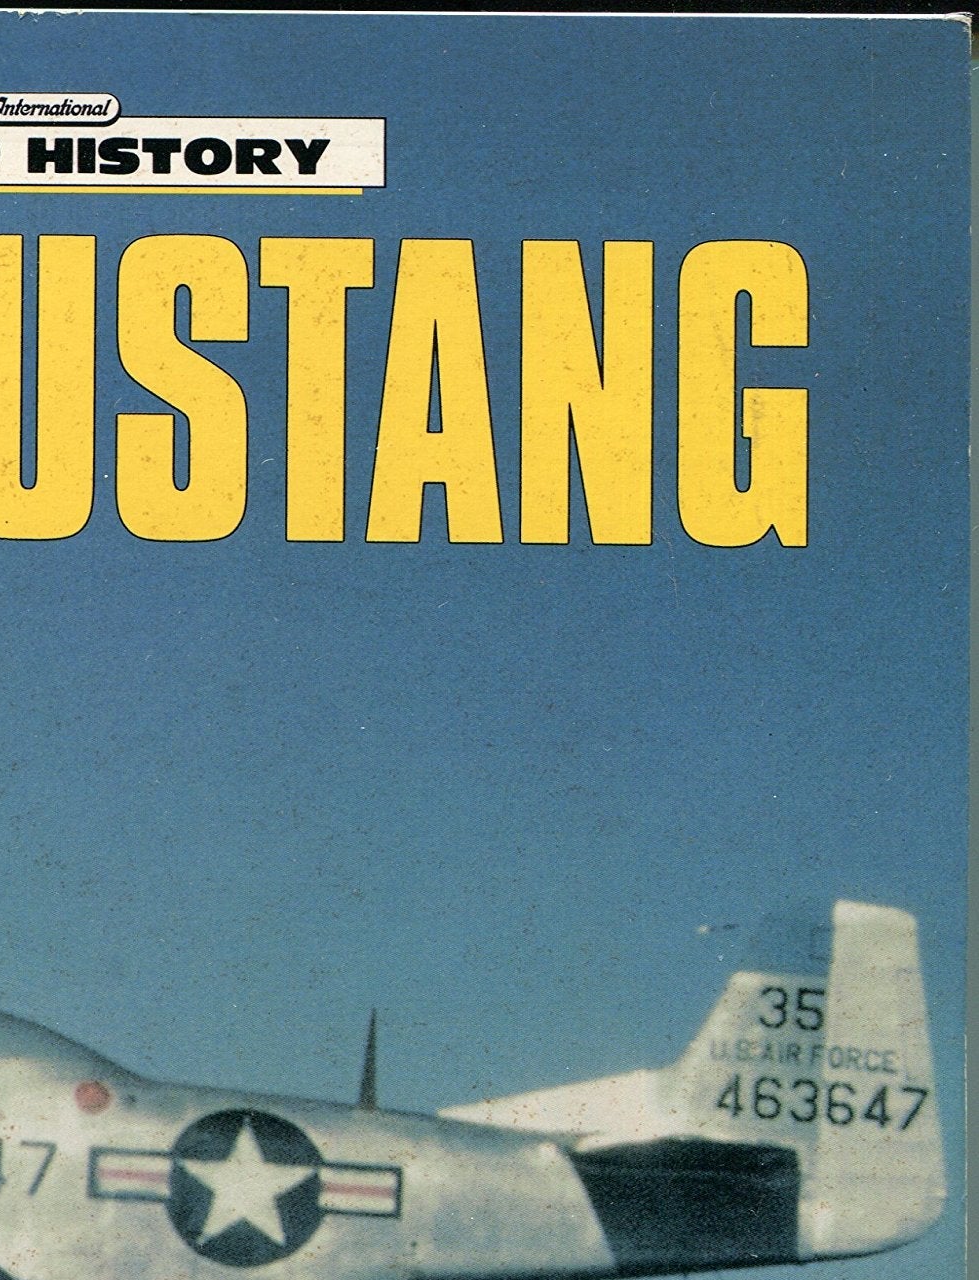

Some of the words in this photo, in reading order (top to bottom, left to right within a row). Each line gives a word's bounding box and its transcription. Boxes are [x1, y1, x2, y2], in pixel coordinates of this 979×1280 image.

[26, 137, 331, 176] HISTORY
[758, 986, 826, 1031] 35
[810, 1043, 898, 1075] FORCE
[716, 1073, 929, 1131] 463647
